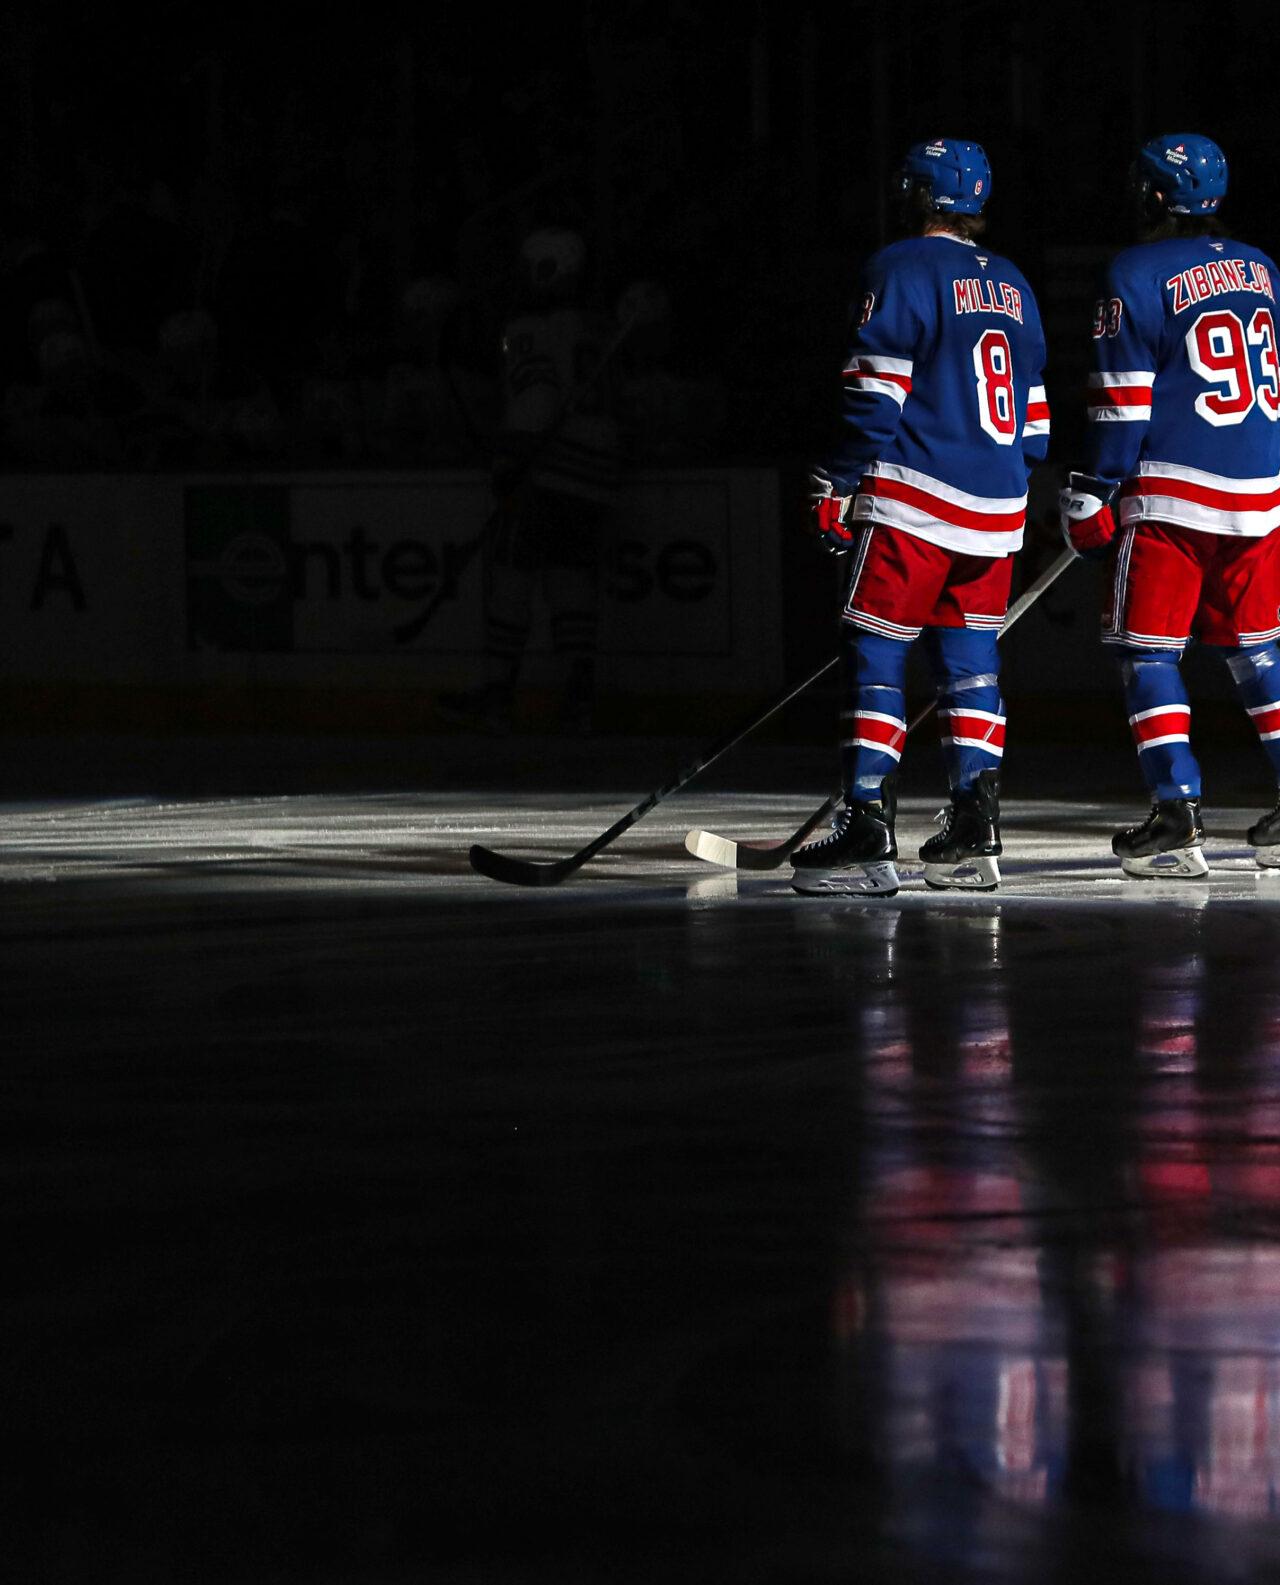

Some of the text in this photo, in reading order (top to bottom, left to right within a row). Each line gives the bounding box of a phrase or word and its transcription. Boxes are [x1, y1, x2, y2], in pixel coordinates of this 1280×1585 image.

[975, 180, 983, 195] 8
[953, 278, 1023, 324] MILLER
[1166, 259, 1276, 315] ZIBANEJA
[972, 329, 1017, 446] 8
[1186, 308, 1280, 427] 93
[0, 521, 87, 612] A
[222, 526, 719, 603] enterse
